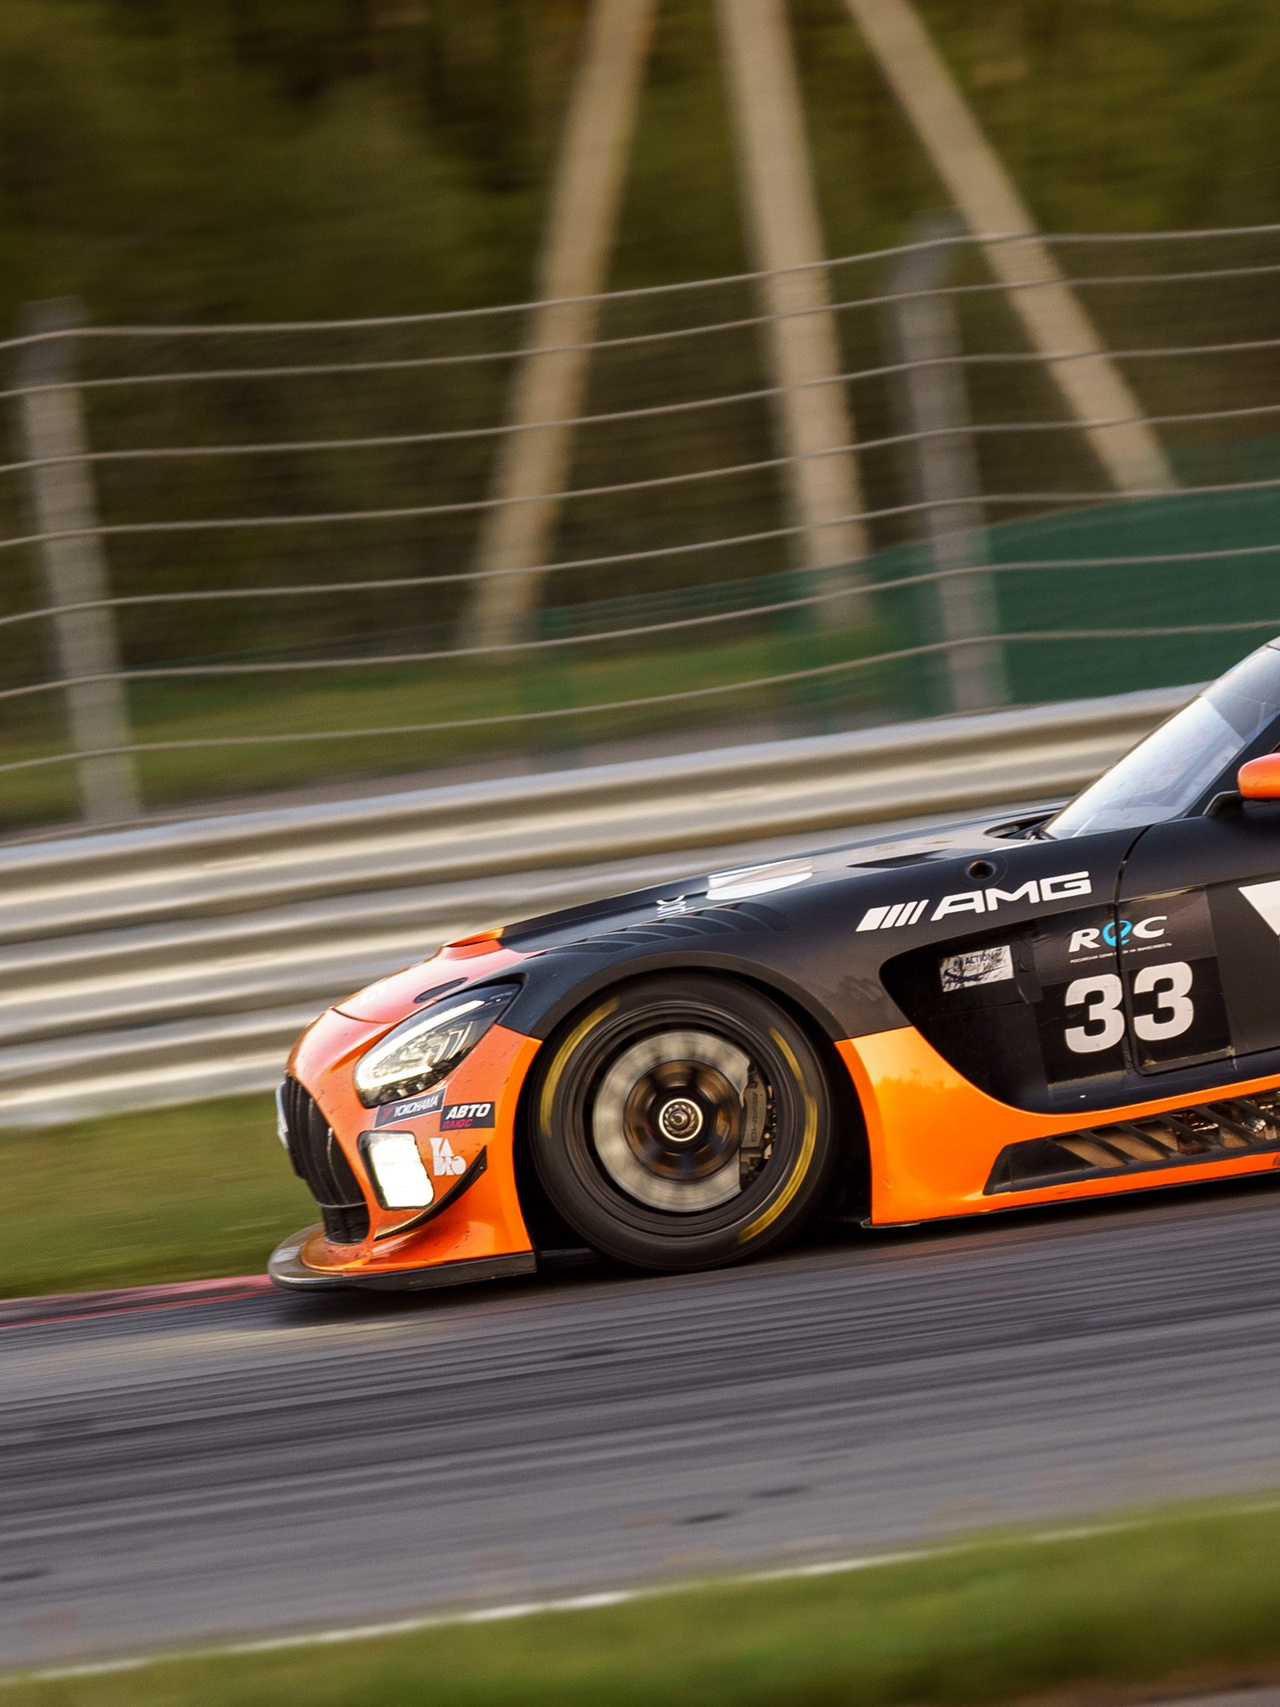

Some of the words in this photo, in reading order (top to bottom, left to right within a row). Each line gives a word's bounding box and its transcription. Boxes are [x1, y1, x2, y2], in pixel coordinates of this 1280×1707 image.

[930, 871, 1092, 921] AMG
[1065, 961, 1194, 1054] 33
[393, 1095, 439, 1117] YOKOHAMA
[445, 1103, 491, 1120] АВТО
